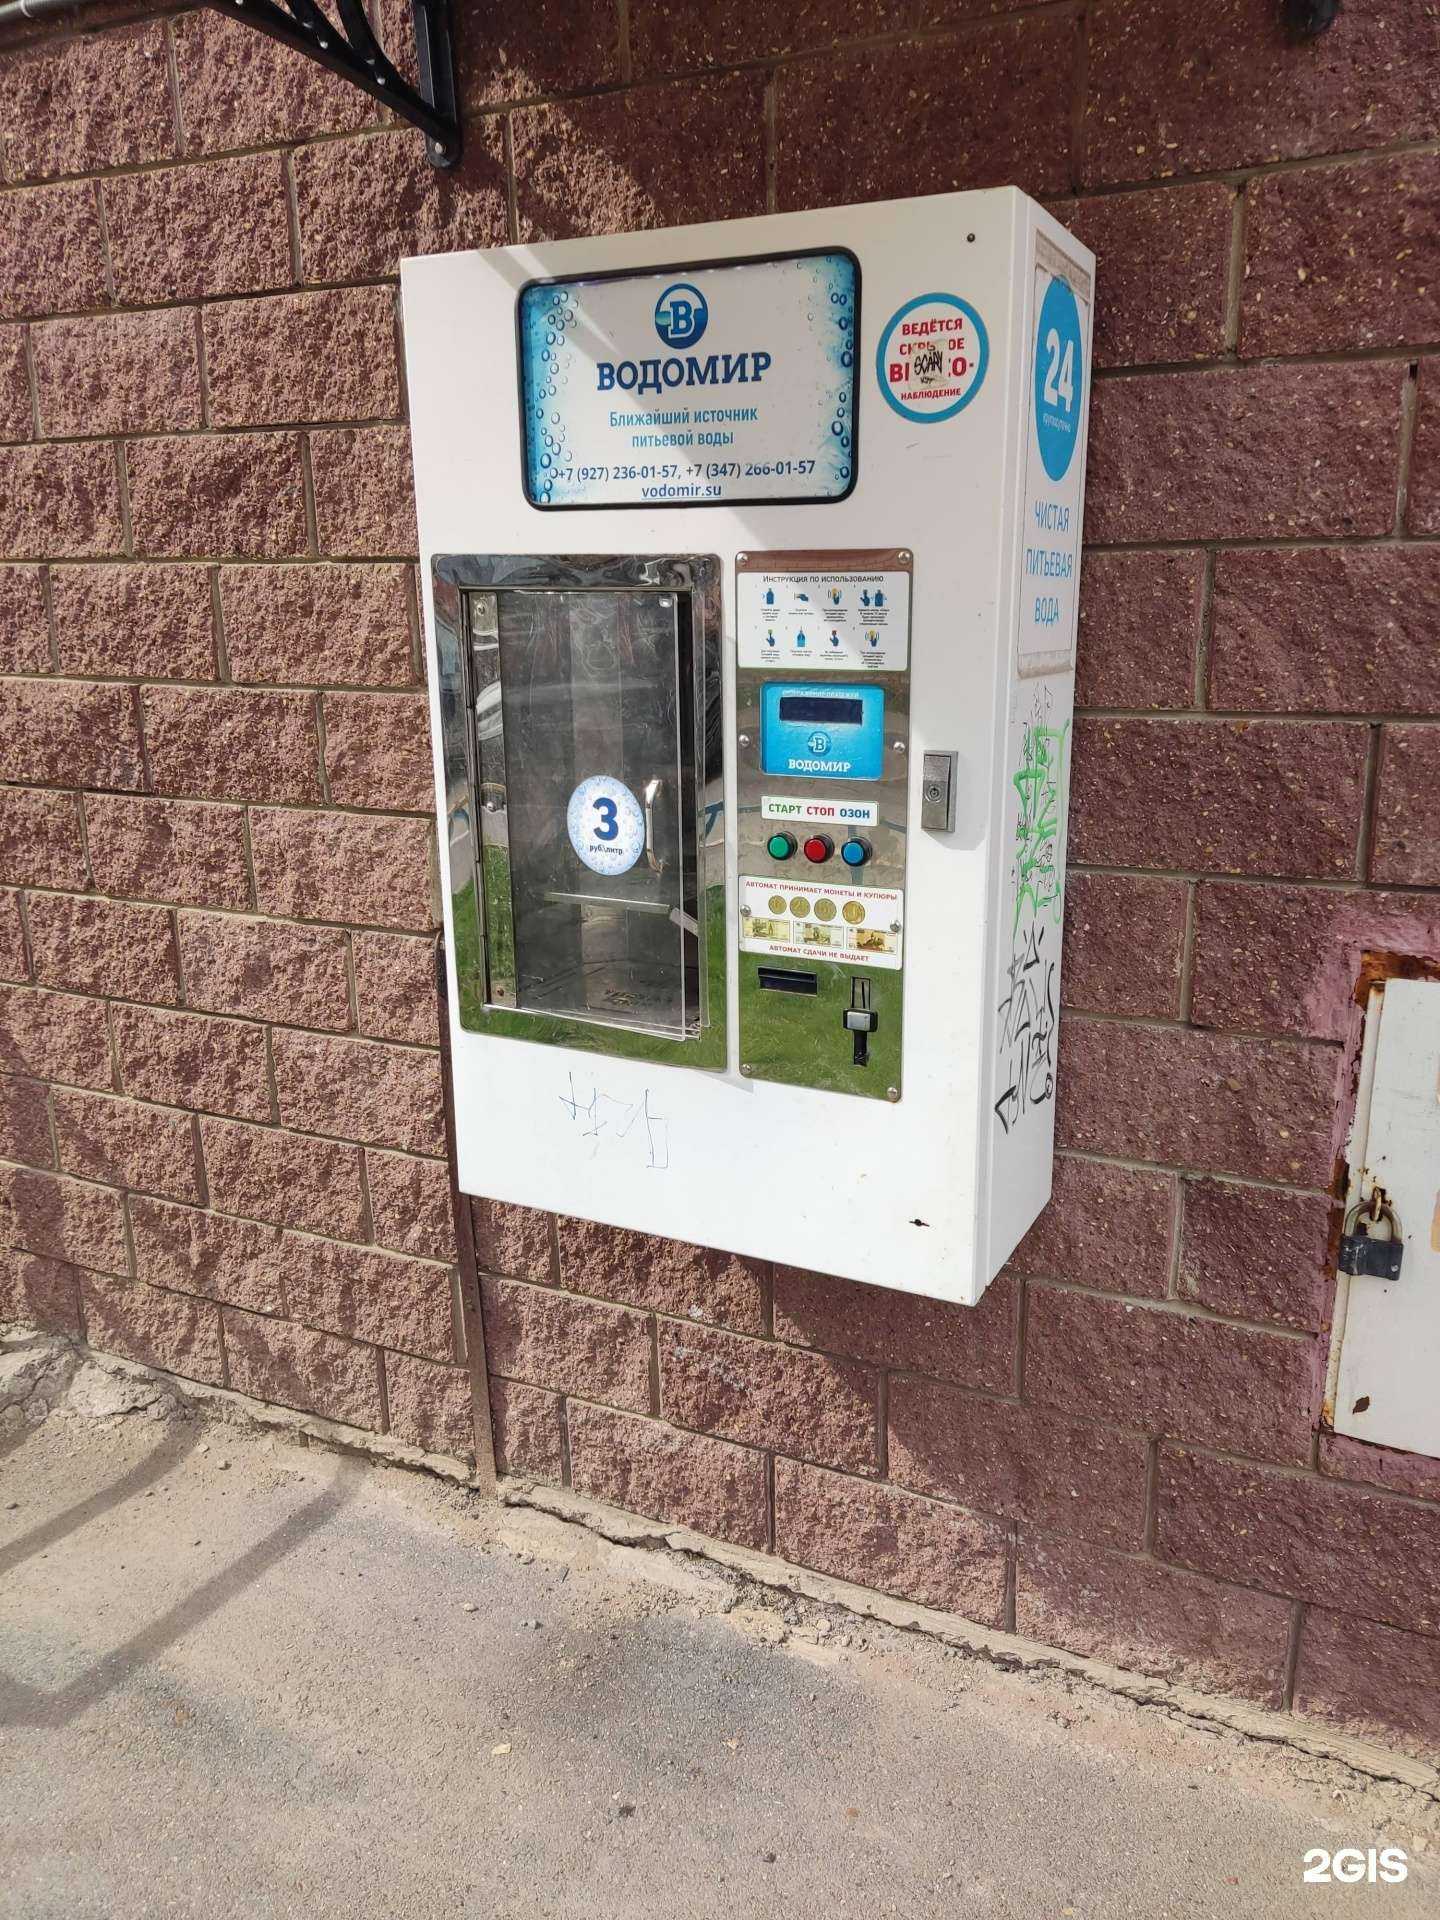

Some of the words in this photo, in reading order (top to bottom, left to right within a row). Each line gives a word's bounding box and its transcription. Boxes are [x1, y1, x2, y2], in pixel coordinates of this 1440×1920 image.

[902, 318, 963, 336] ВЕДЁТСЯ
[596, 351, 772, 395] ВОДОМИР
[1044, 327, 1074, 413] 24
[901, 387, 961, 400] НАБЛЮДЕНИЕ
[609, 407, 690, 428] Ближайший
[693, 407, 758, 424] источник
[631, 429, 694, 448] питьевой
[697, 430, 734, 447] воды
[558, 467, 573, 481] +7
[576, 466, 609, 482] (927)
[612, 464, 681, 481] 236-01-57,
[686, 465, 702, 479] +7
[706, 462, 741, 479] (347)
[745, 460, 816, 477] 266-01-57
[641, 483, 722, 498] vodomir.su
[1035, 500, 1070, 532] ЧИСТАЯ
[1026, 548, 1073, 578] ПИТЬЕВАЯ
[1034, 597, 1060, 627] ВОДА
[788, 758, 852, 773] ВОДОМИР
[592, 797, 619, 842] 3
[768, 803, 802, 814] СТАРТ
[806, 806, 835, 817] СТОП
[839, 808, 870, 819] ОЗОН
[745, 880, 778, 890] АВТОМАТ
[779, 884, 822, 894] ПРИНИМАЕТ
[824, 888, 855, 897] МОНЕТЫ
[864, 892, 897, 901] КУПЮРЫ
[769, 944, 801, 954] АВТОМАТ
[803, 948, 827, 957] СДАЧИ
[829, 951, 837, 959] НЕ
[840, 953, 868, 962] ВЫДАЕТ
